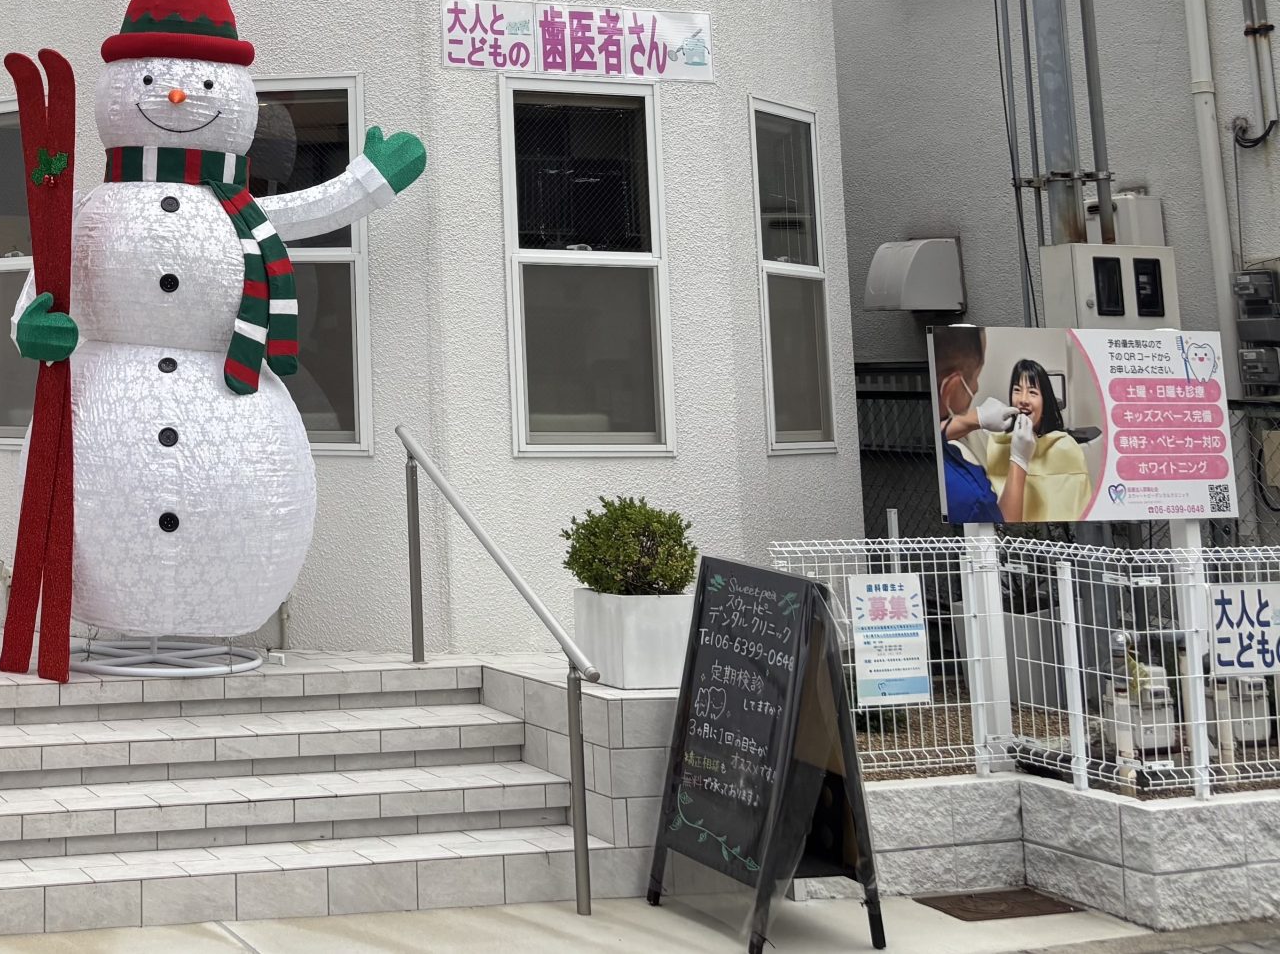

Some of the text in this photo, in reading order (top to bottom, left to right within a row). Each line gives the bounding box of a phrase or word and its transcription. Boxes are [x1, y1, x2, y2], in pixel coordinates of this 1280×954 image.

[447, 1, 505, 35] 大人と
[447, 37, 530, 68] こどもの
[539, 5, 667, 76] 歯医者さん
[1123, 410, 1212, 423] キッズスペース完備
[1138, 461, 1207, 475] ホワイトニング
[728, 577, 777, 602] Sweetpea
[868, 595, 908, 621] 募集
[1214, 589, 1271, 630] 大人と
[1217, 630, 1280, 668] こども
[711, 659, 764, 694] 定期検診
